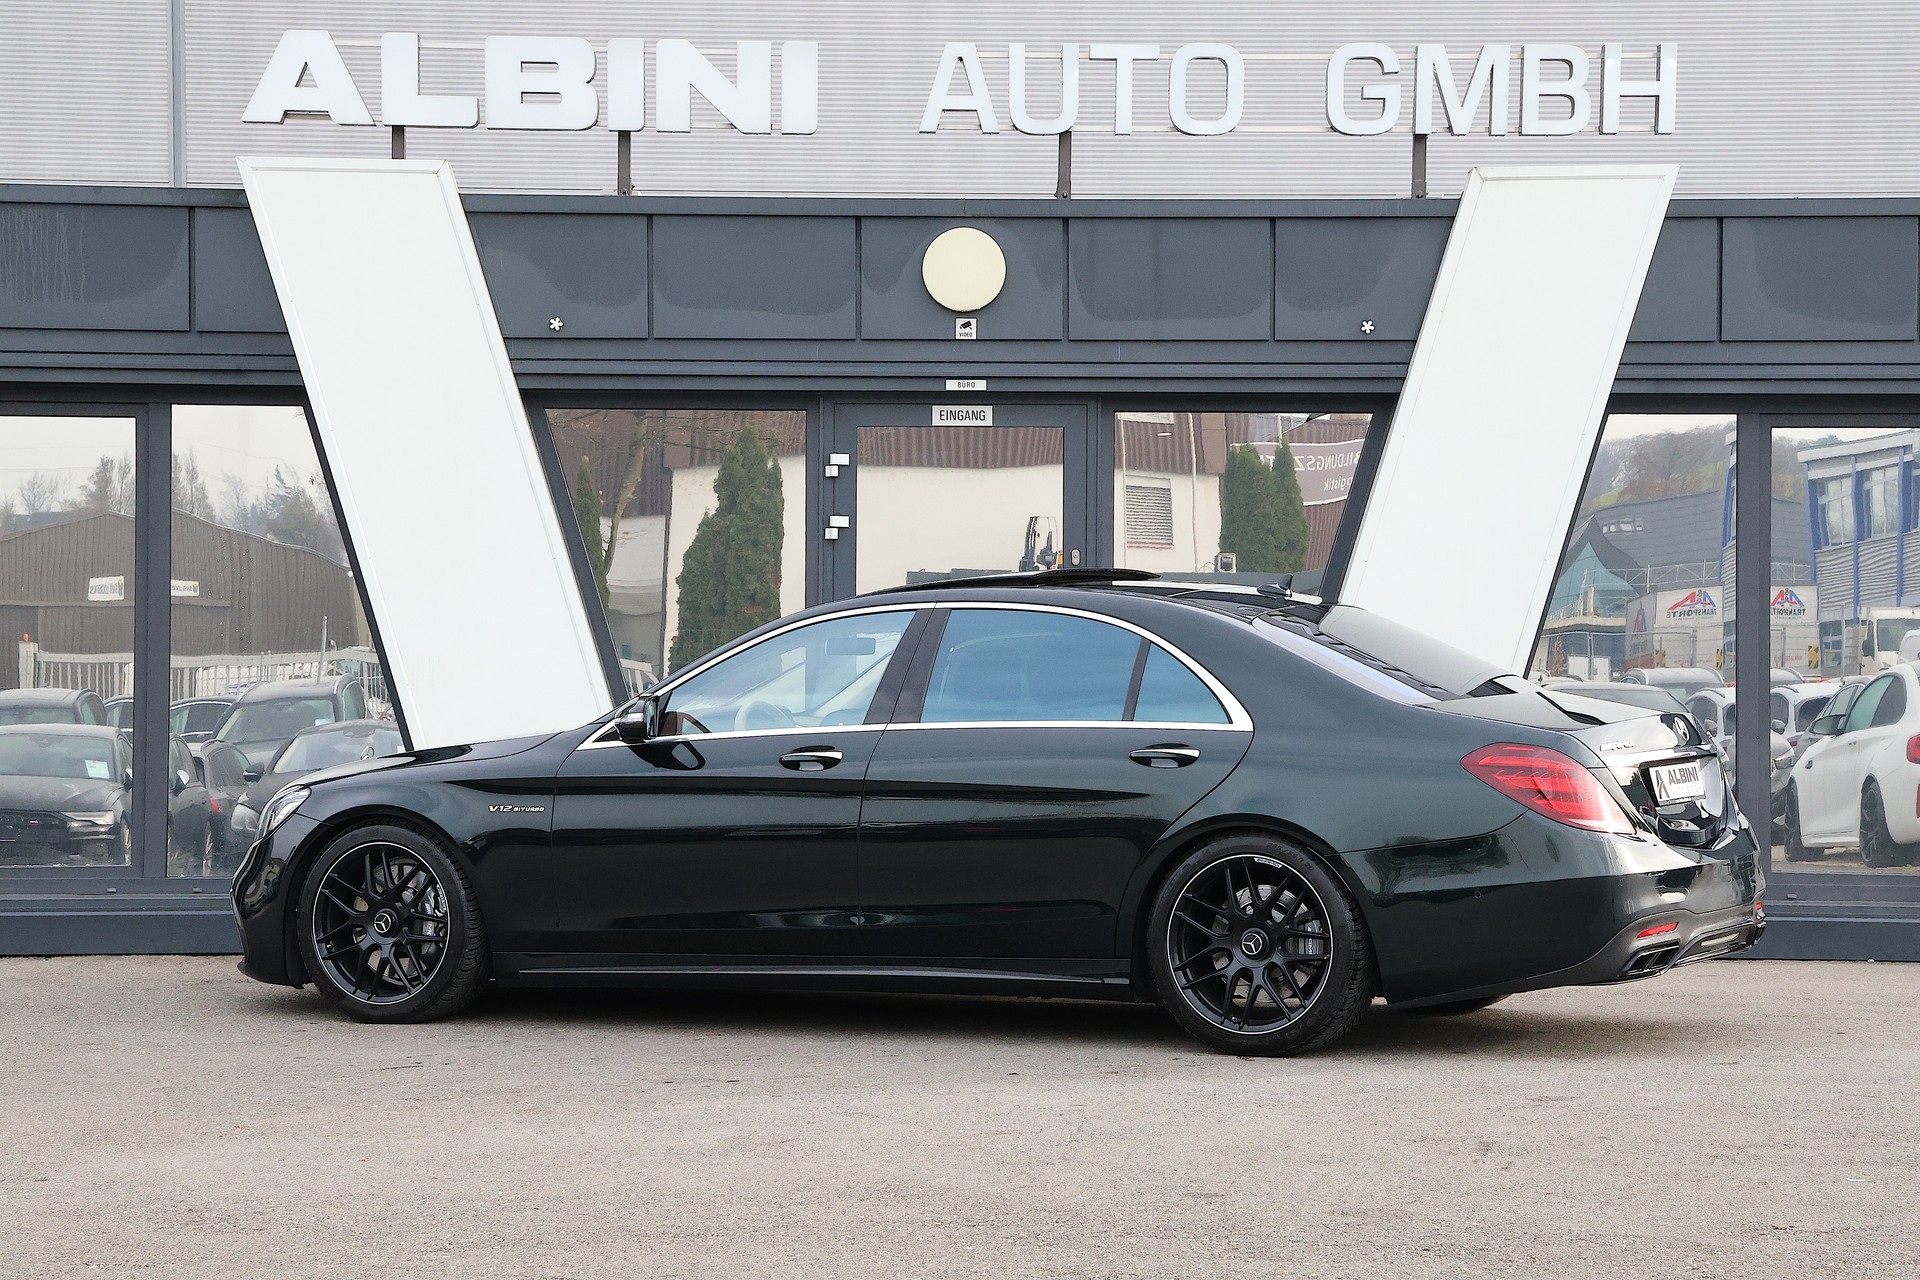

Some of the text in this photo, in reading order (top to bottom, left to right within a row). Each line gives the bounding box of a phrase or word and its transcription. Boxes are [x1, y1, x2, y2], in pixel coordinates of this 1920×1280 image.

[242, 29, 1679, 138] ALBINI AUTO GMBH
[957, 381, 976, 389] BÜRO
[939, 409, 986, 421] EINGANG
[1667, 766, 1700, 786] ALBINI
